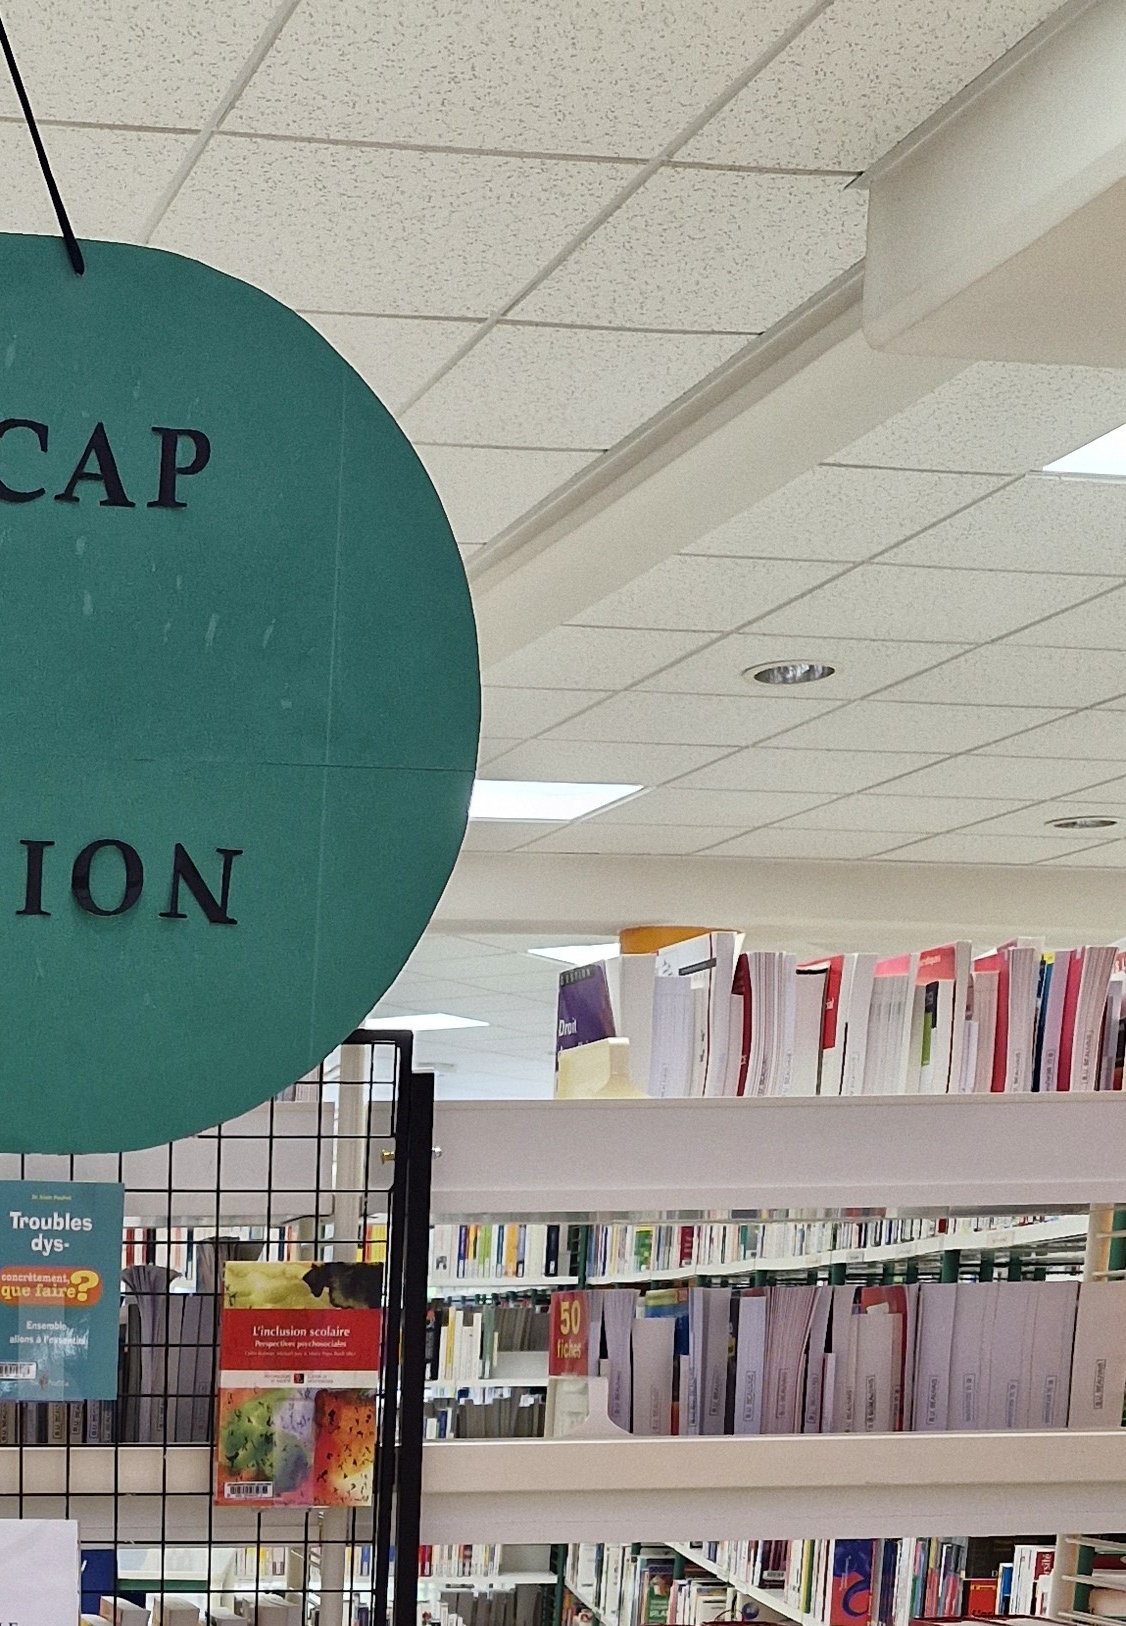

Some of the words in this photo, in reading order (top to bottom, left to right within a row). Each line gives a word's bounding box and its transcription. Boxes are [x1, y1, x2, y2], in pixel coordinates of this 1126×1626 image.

[559, 1019, 577, 1036] Droit
[9, 1211, 92, 1231] Troubles
[31, 1234, 69, 1256] dys-
[1, 1286, 30, 1300] que
[560, 1300, 580, 1335] 50
[253, 1325, 306, 1336] L'inclusion
[310, 1325, 350, 1336] scolaire
[10, 1335, 34, 1344] allons
[255, 1340, 295, 1349] Perspectives
[297, 1340, 346, 1349] psychosociales
[557, 1340, 582, 1359] fiches
